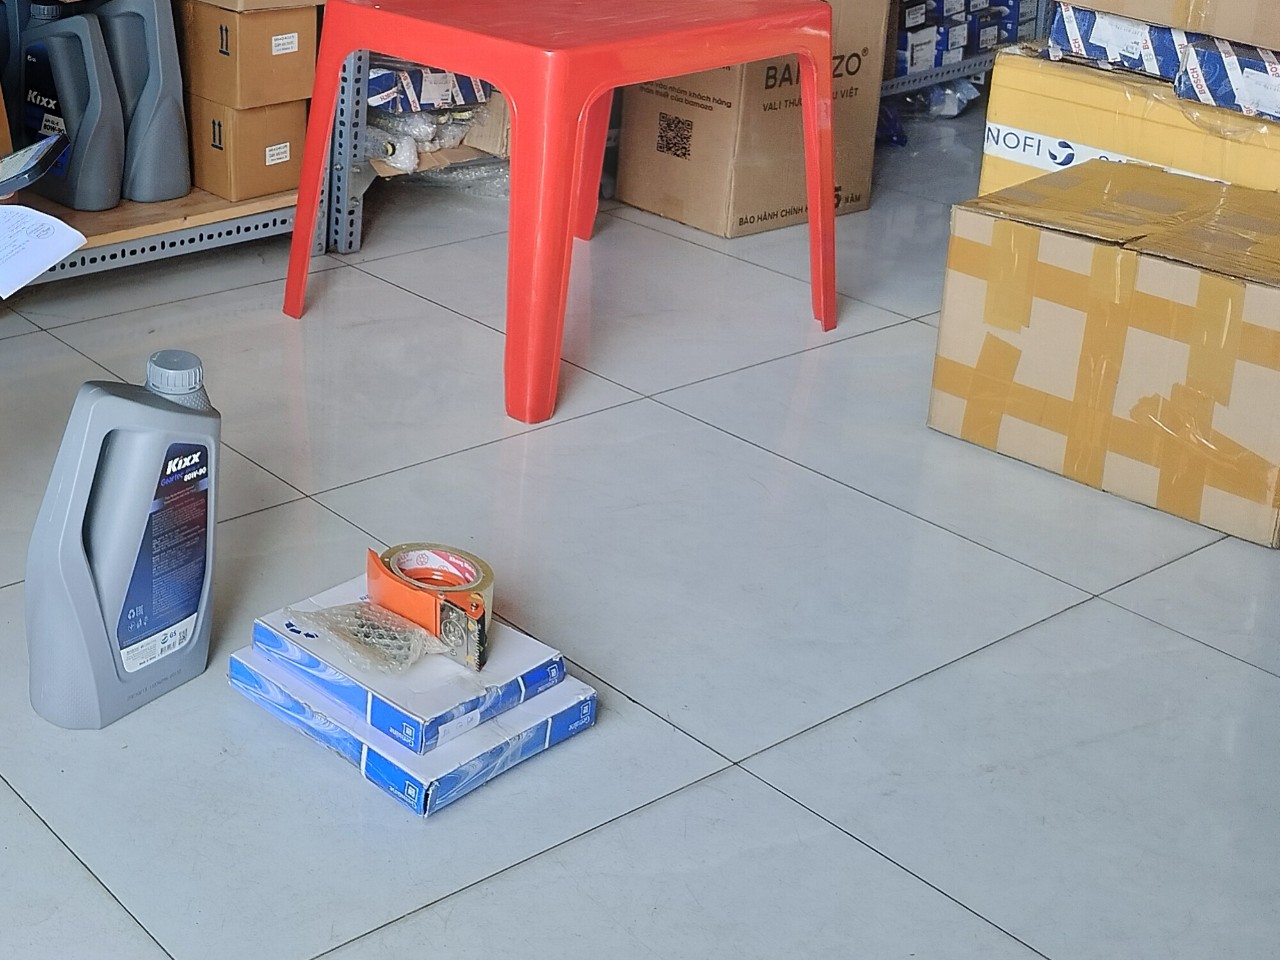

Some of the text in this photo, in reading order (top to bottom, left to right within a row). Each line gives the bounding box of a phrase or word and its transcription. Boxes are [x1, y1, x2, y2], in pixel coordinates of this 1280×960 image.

[764, 52, 862, 90] BAZO
[1189, 67, 1207, 95] BOSCH
[27, 89, 57, 110] Kixx
[668, 85, 688, 97] nhóm
[688, 90, 711, 102] khách
[712, 96, 732, 109] hàng
[669, 93, 684, 103] của
[684, 97, 714, 111] bamozo
[841, 86, 859, 99] VIỆT
[762, 100, 782, 112] VALI
[165, 451, 202, 475] Kixx
[169, 630, 177, 639] GS
[388, 726, 414, 747] Genuine
[388, 785, 418, 809] Genuine
